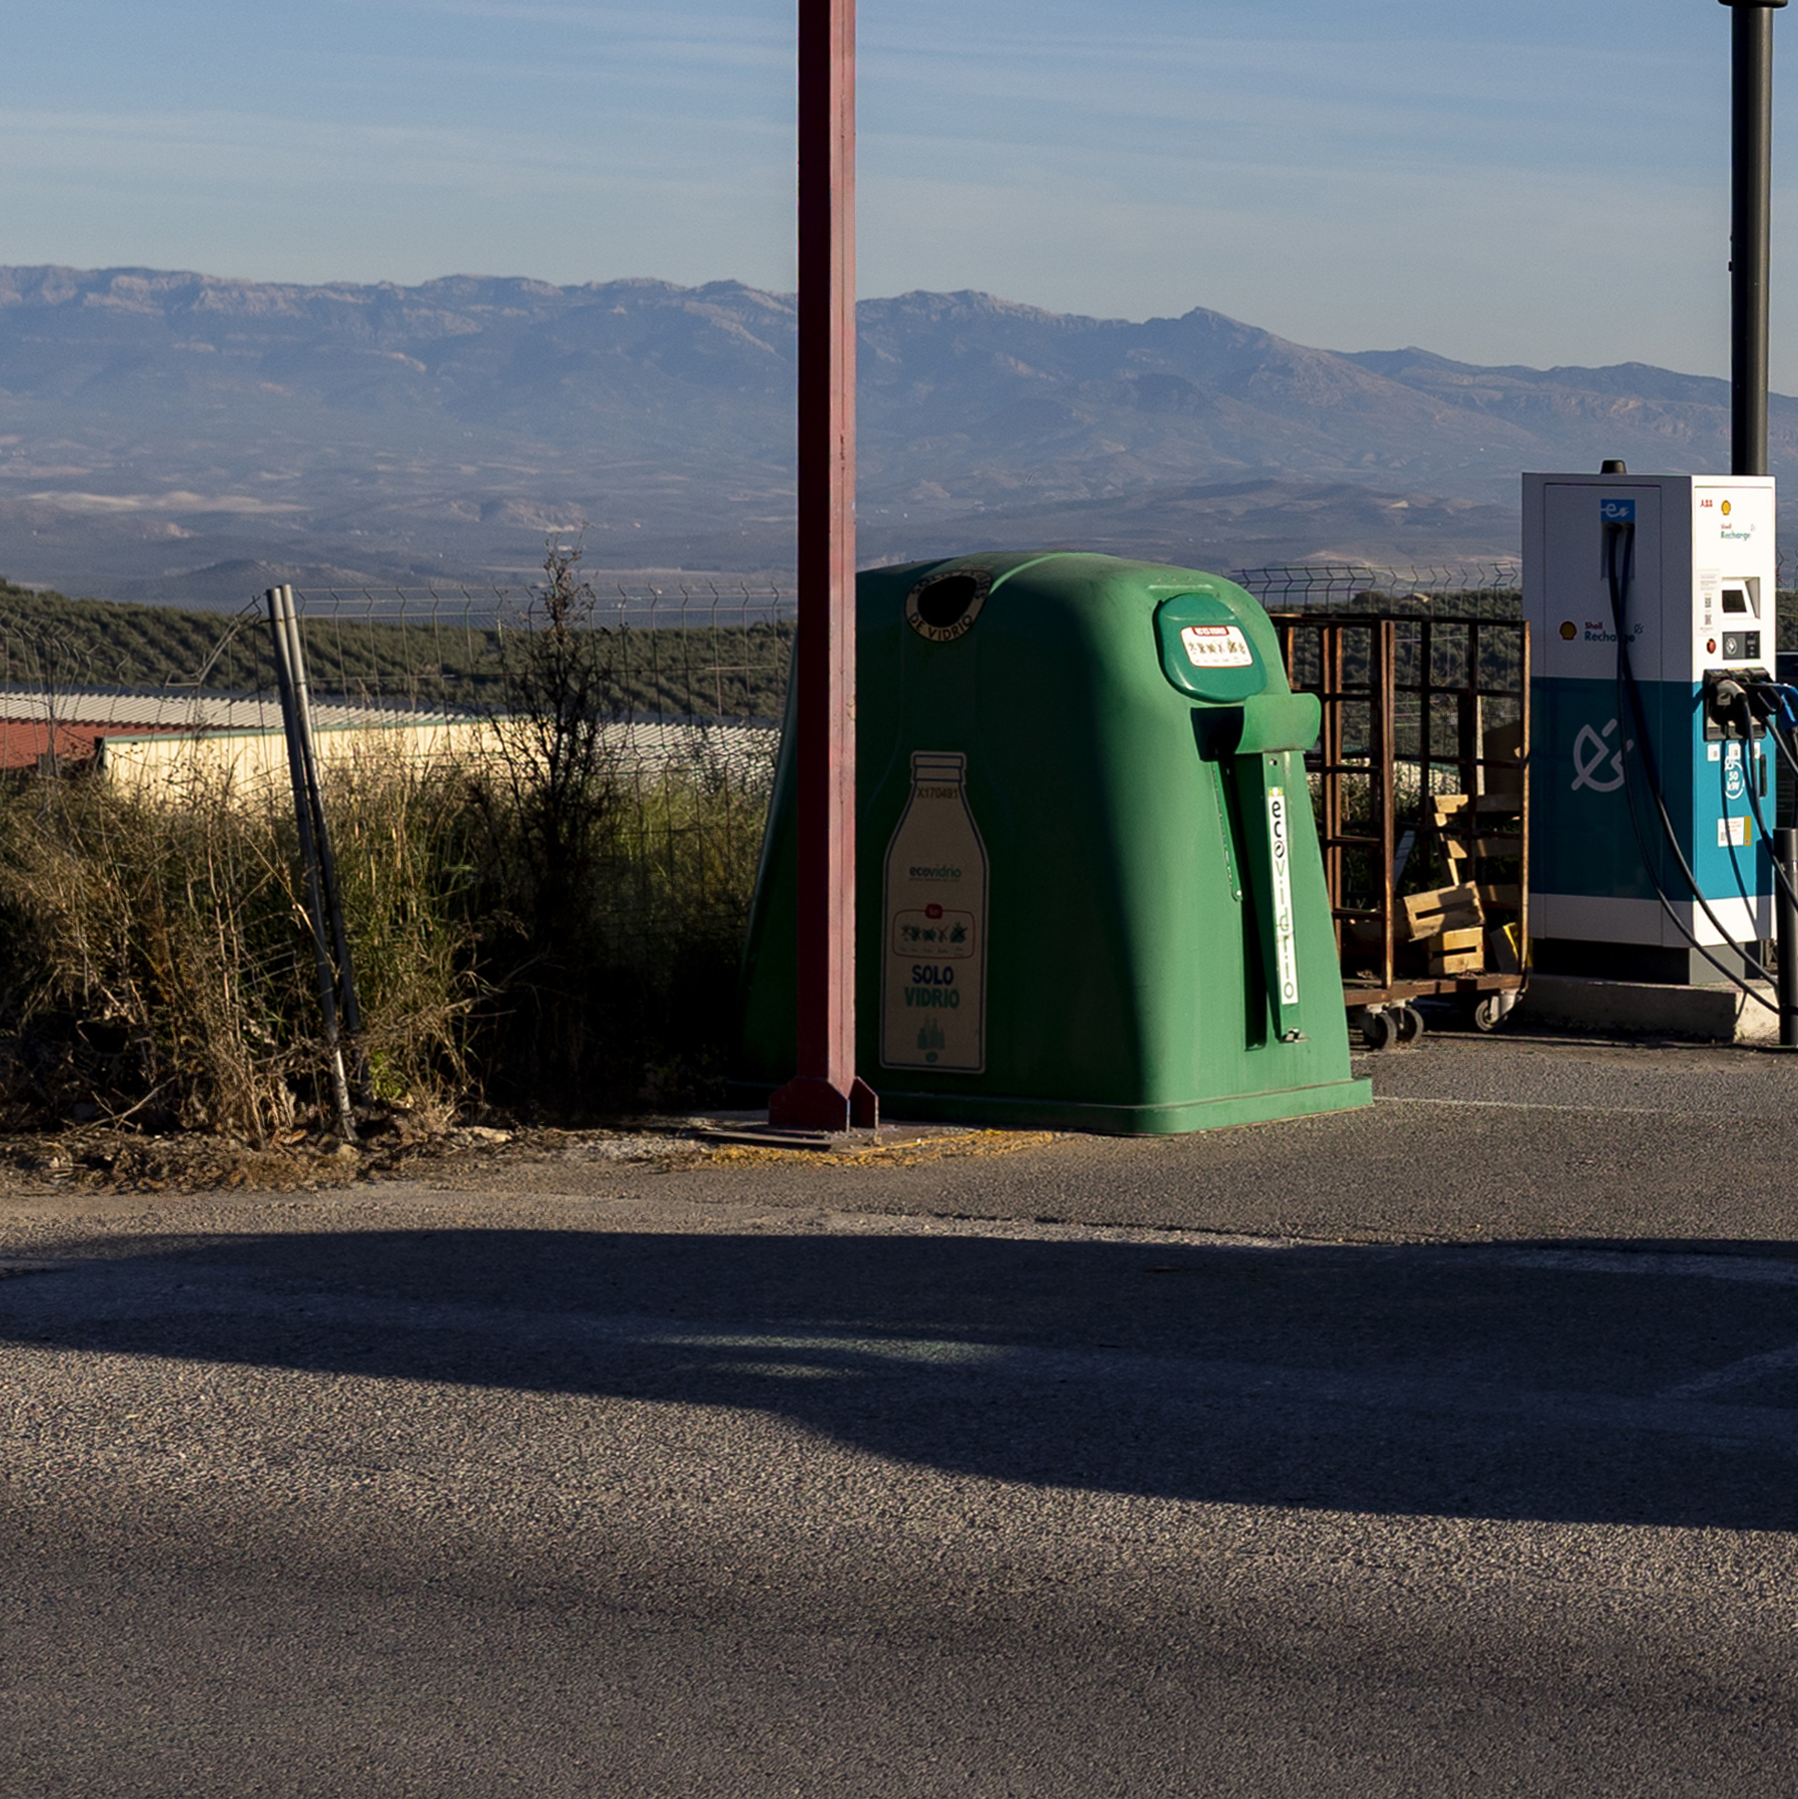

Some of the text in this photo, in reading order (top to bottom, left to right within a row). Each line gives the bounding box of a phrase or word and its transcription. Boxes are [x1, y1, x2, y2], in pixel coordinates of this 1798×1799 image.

[909, 612, 973, 641] DE VIDRIO
[909, 863, 962, 878] ecovidrio
[1270, 800, 1294, 1000] ecovidrio
[911, 964, 955, 986] SOLO
[904, 986, 961, 1009] VIDRIO
